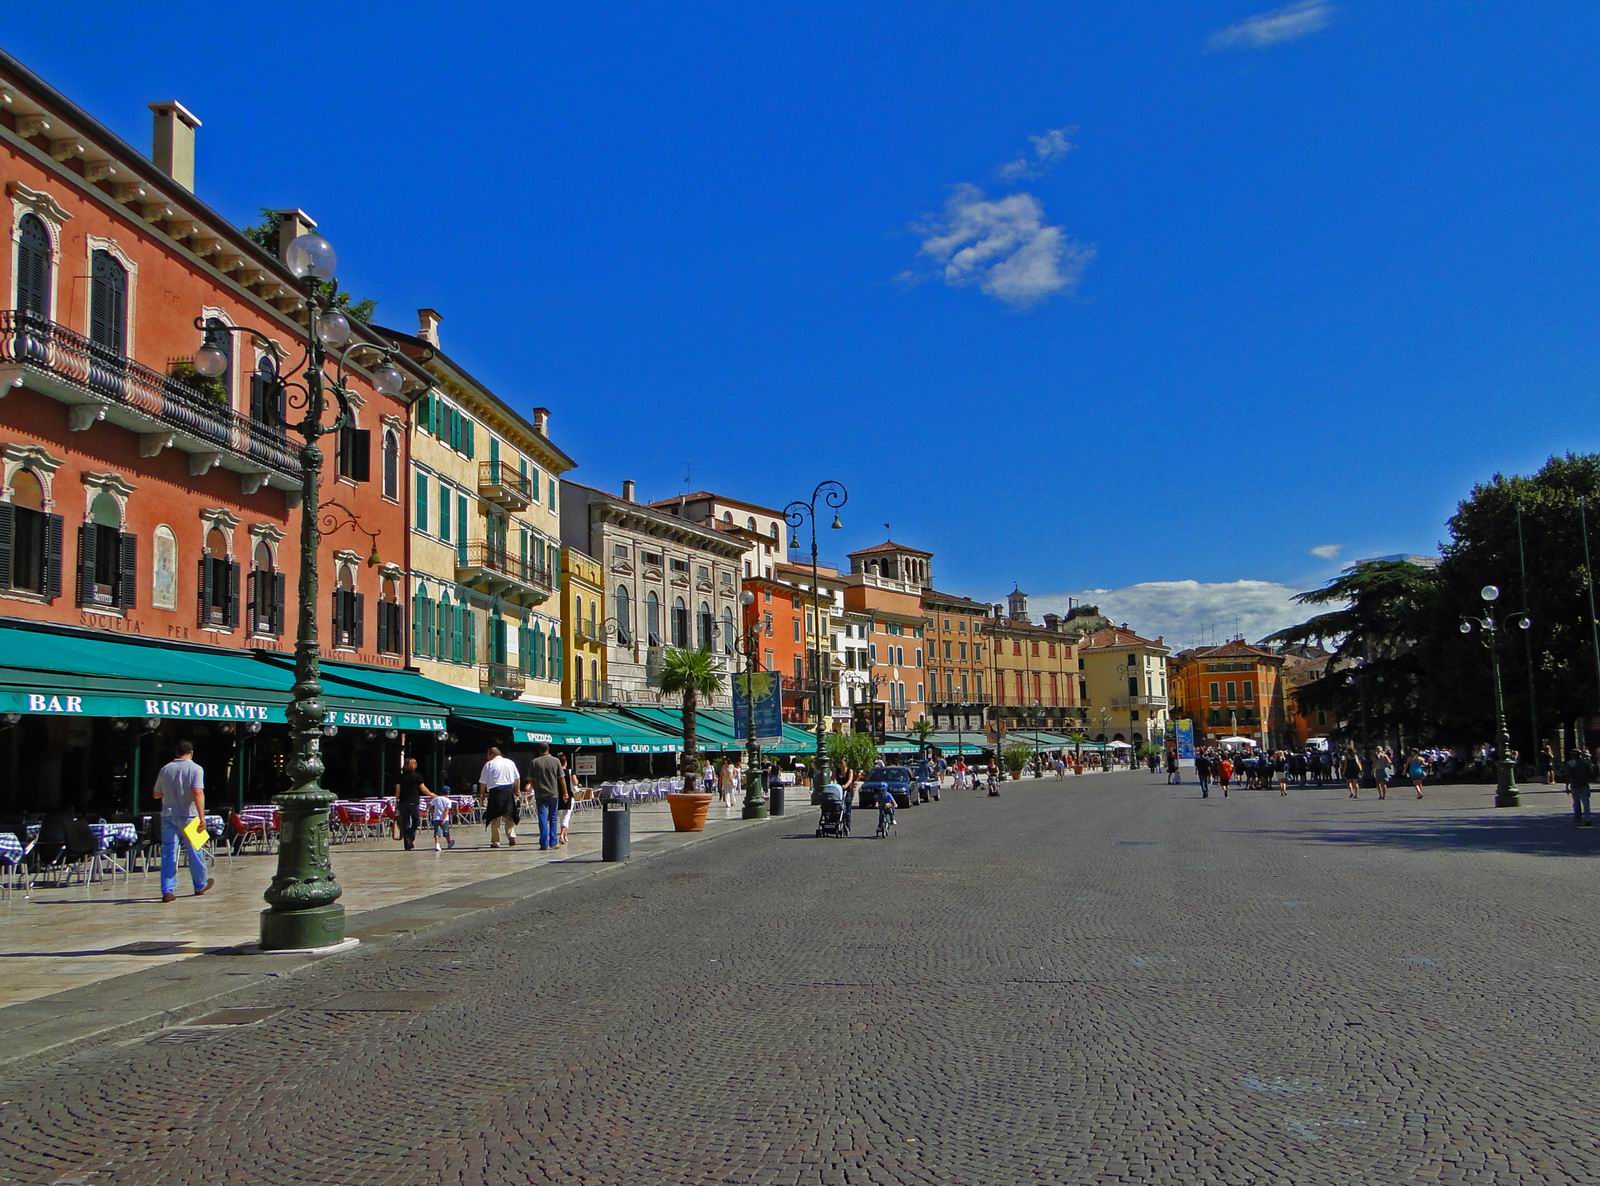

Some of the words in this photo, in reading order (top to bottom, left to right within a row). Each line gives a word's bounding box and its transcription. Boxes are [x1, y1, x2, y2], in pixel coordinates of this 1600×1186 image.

[168, 625, 189, 639] PER
[210, 632, 220, 644] IL
[245, 638, 283, 651] TURISMO
[29, 694, 82, 712] BAR
[145, 699, 268, 719] RISTORANTE
[344, 712, 393, 726] SERVICE
[527, 732, 552, 743] SPIZZICO
[631, 744, 649, 752] OLIVO
